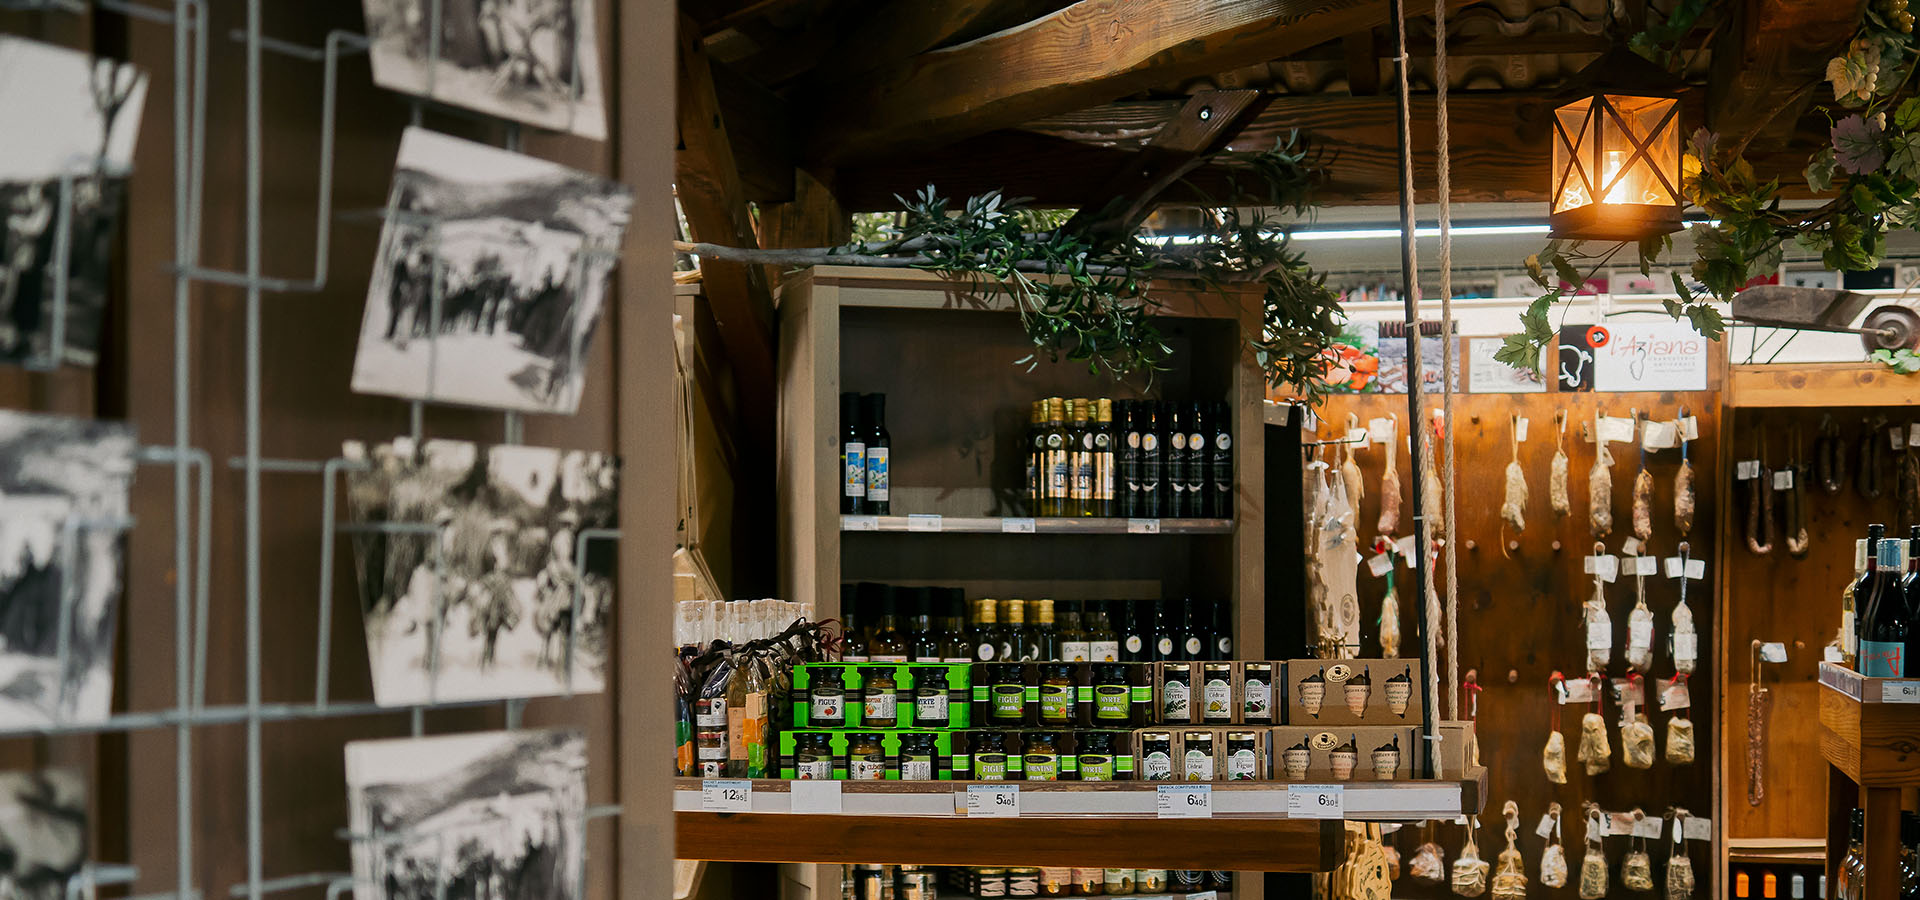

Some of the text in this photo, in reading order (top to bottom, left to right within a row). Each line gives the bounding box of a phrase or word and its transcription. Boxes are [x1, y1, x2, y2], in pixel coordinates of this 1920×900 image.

[818, 698, 837, 706] FIGUE
[997, 696, 1020, 704] FIGUE
[982, 765, 1005, 773] FIGUE
[1148, 764, 1167, 772] Myrte
[1236, 762, 1253, 770] Figue
